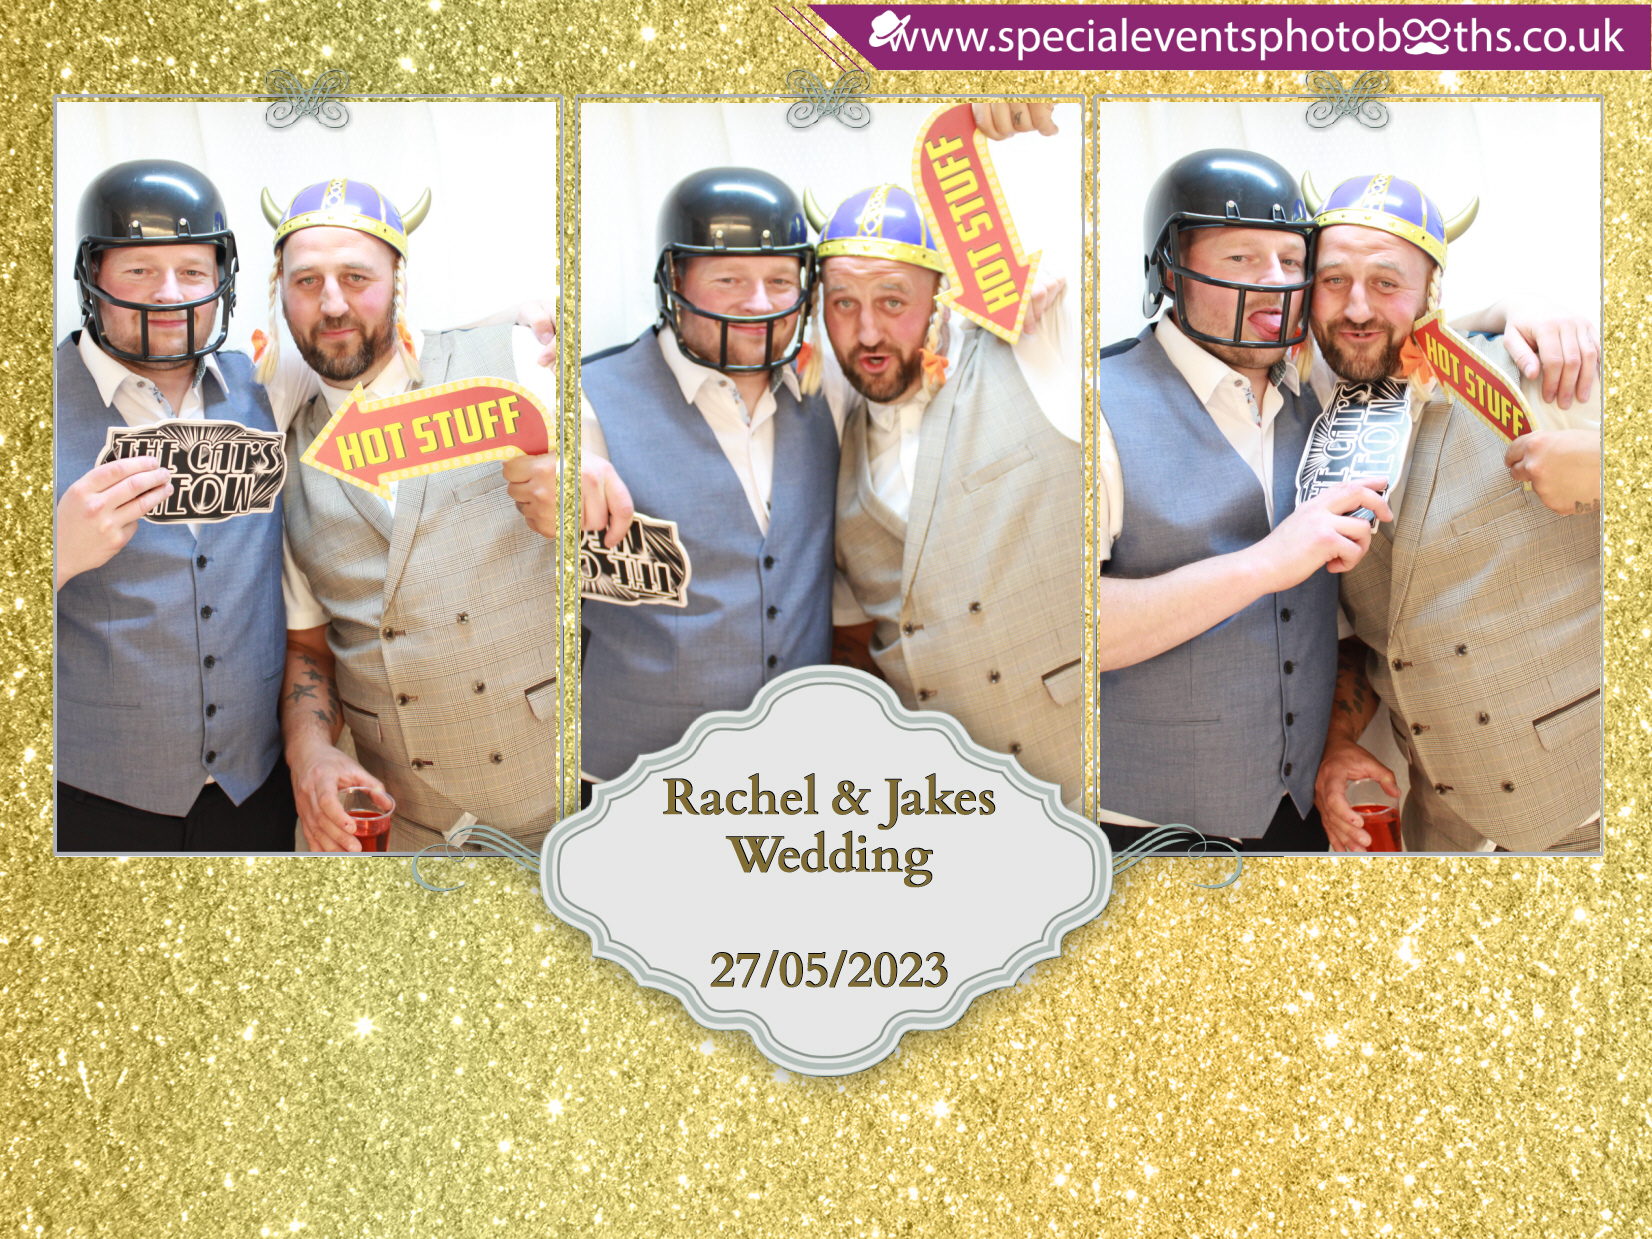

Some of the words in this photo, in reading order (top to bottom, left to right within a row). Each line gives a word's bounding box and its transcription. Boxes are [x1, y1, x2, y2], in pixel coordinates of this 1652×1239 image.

[925, 135, 994, 242] STUFF
[966, 241, 1020, 314] HOT
[1425, 331, 1461, 385] HOT
[1464, 364, 1525, 437] STUFF
[187, 440, 279, 474] CAT'S
[335, 422, 406, 471] HOT
[411, 395, 521, 454] STUFF
[1323, 384, 1372, 460] CAT'S
[146, 474, 255, 515] EOW
[606, 554, 678, 597] THE
